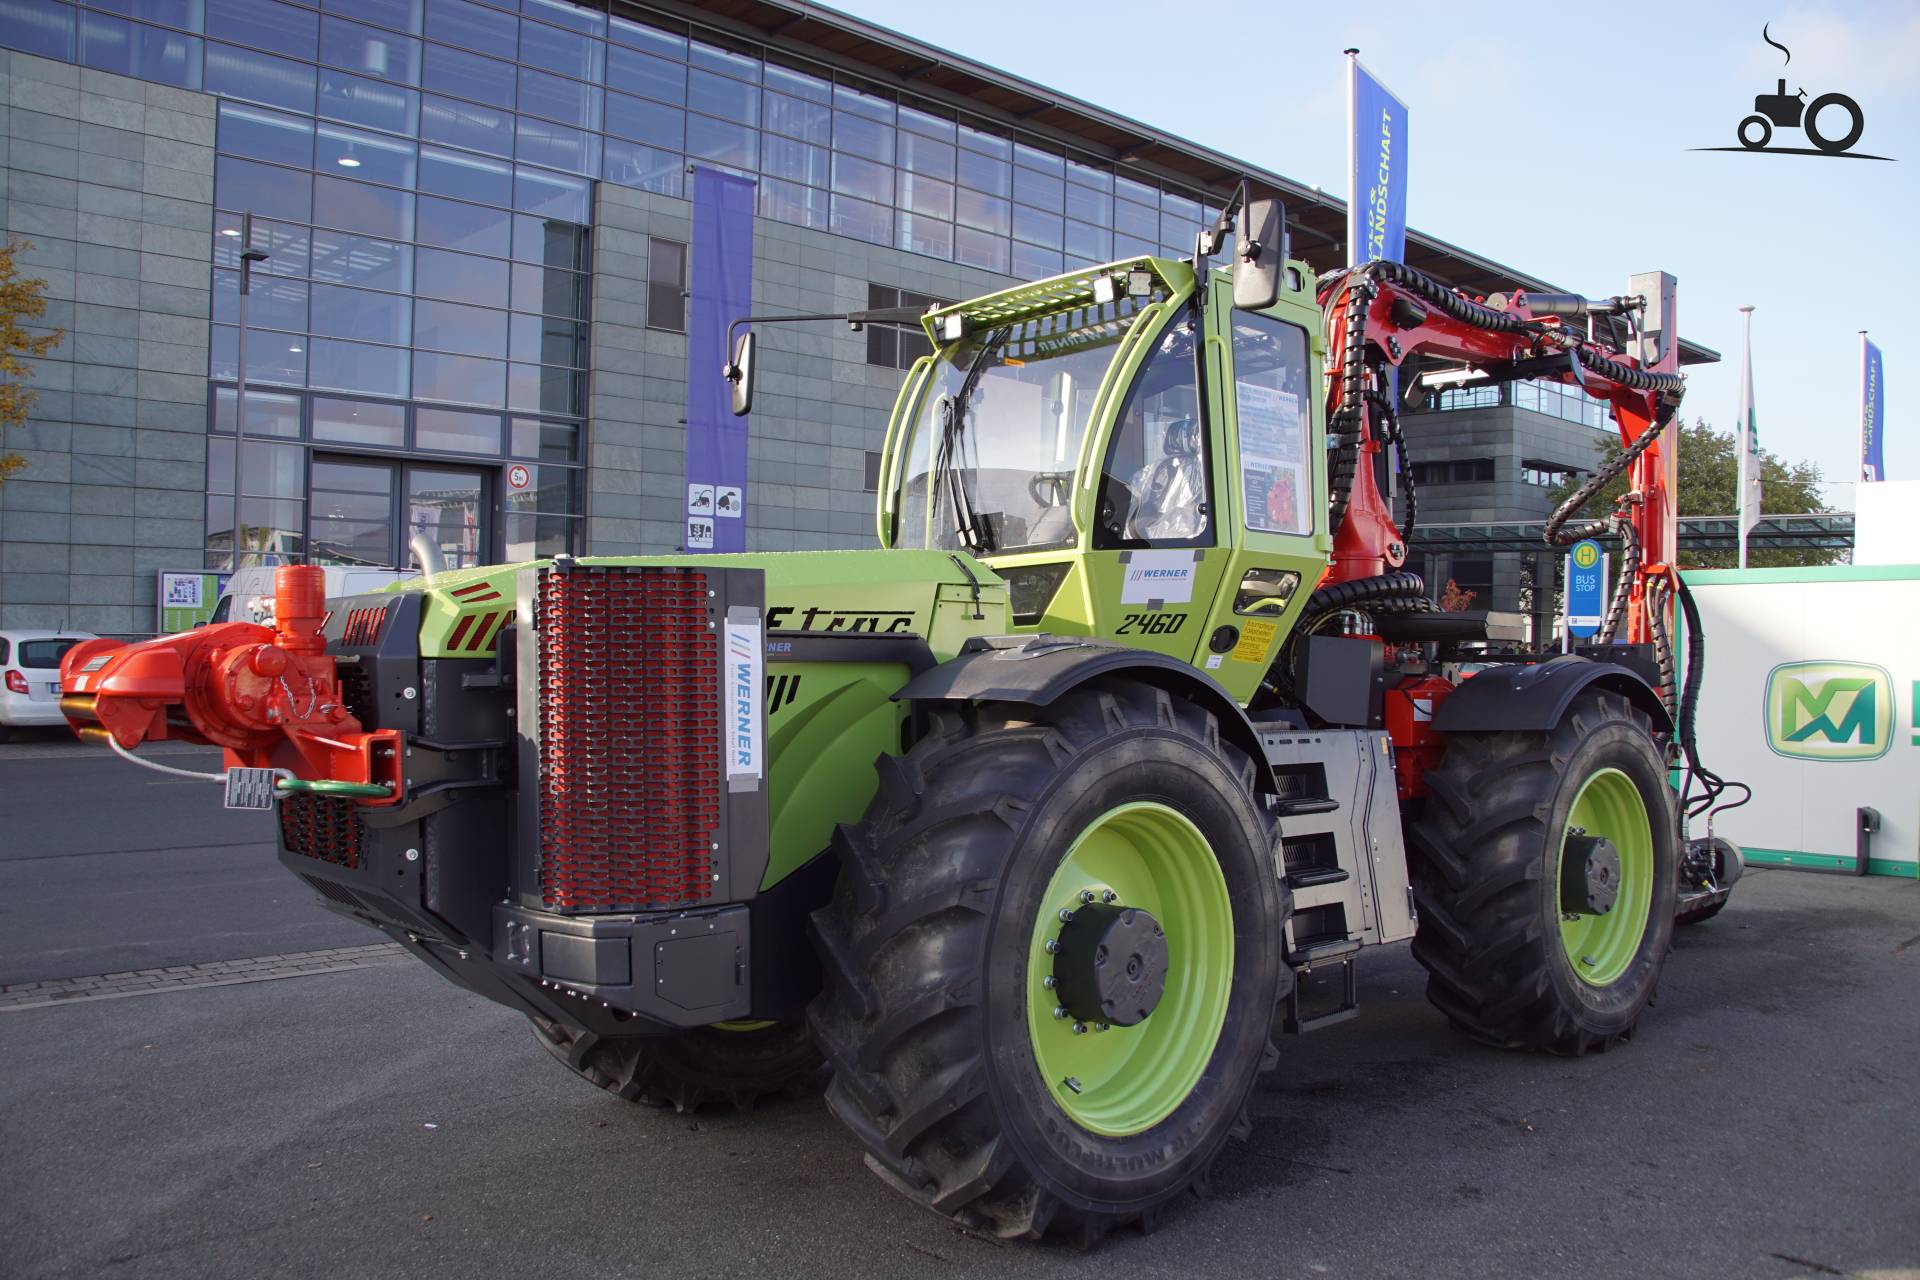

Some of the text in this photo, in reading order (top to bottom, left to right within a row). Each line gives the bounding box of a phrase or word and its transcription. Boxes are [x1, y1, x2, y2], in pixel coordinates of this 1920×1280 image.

[1372, 107, 1391, 262] LANDSCHAFT
[1867, 357, 1876, 446] LANDSCHAFT
[1581, 548, 1591, 561] H
[1143, 569, 1188, 578] WERNER
[1575, 575, 1596, 585] BUS
[1115, 613, 1188, 635] 2460
[766, 642, 792, 652] NER
[737, 663, 751, 766] WERNER
